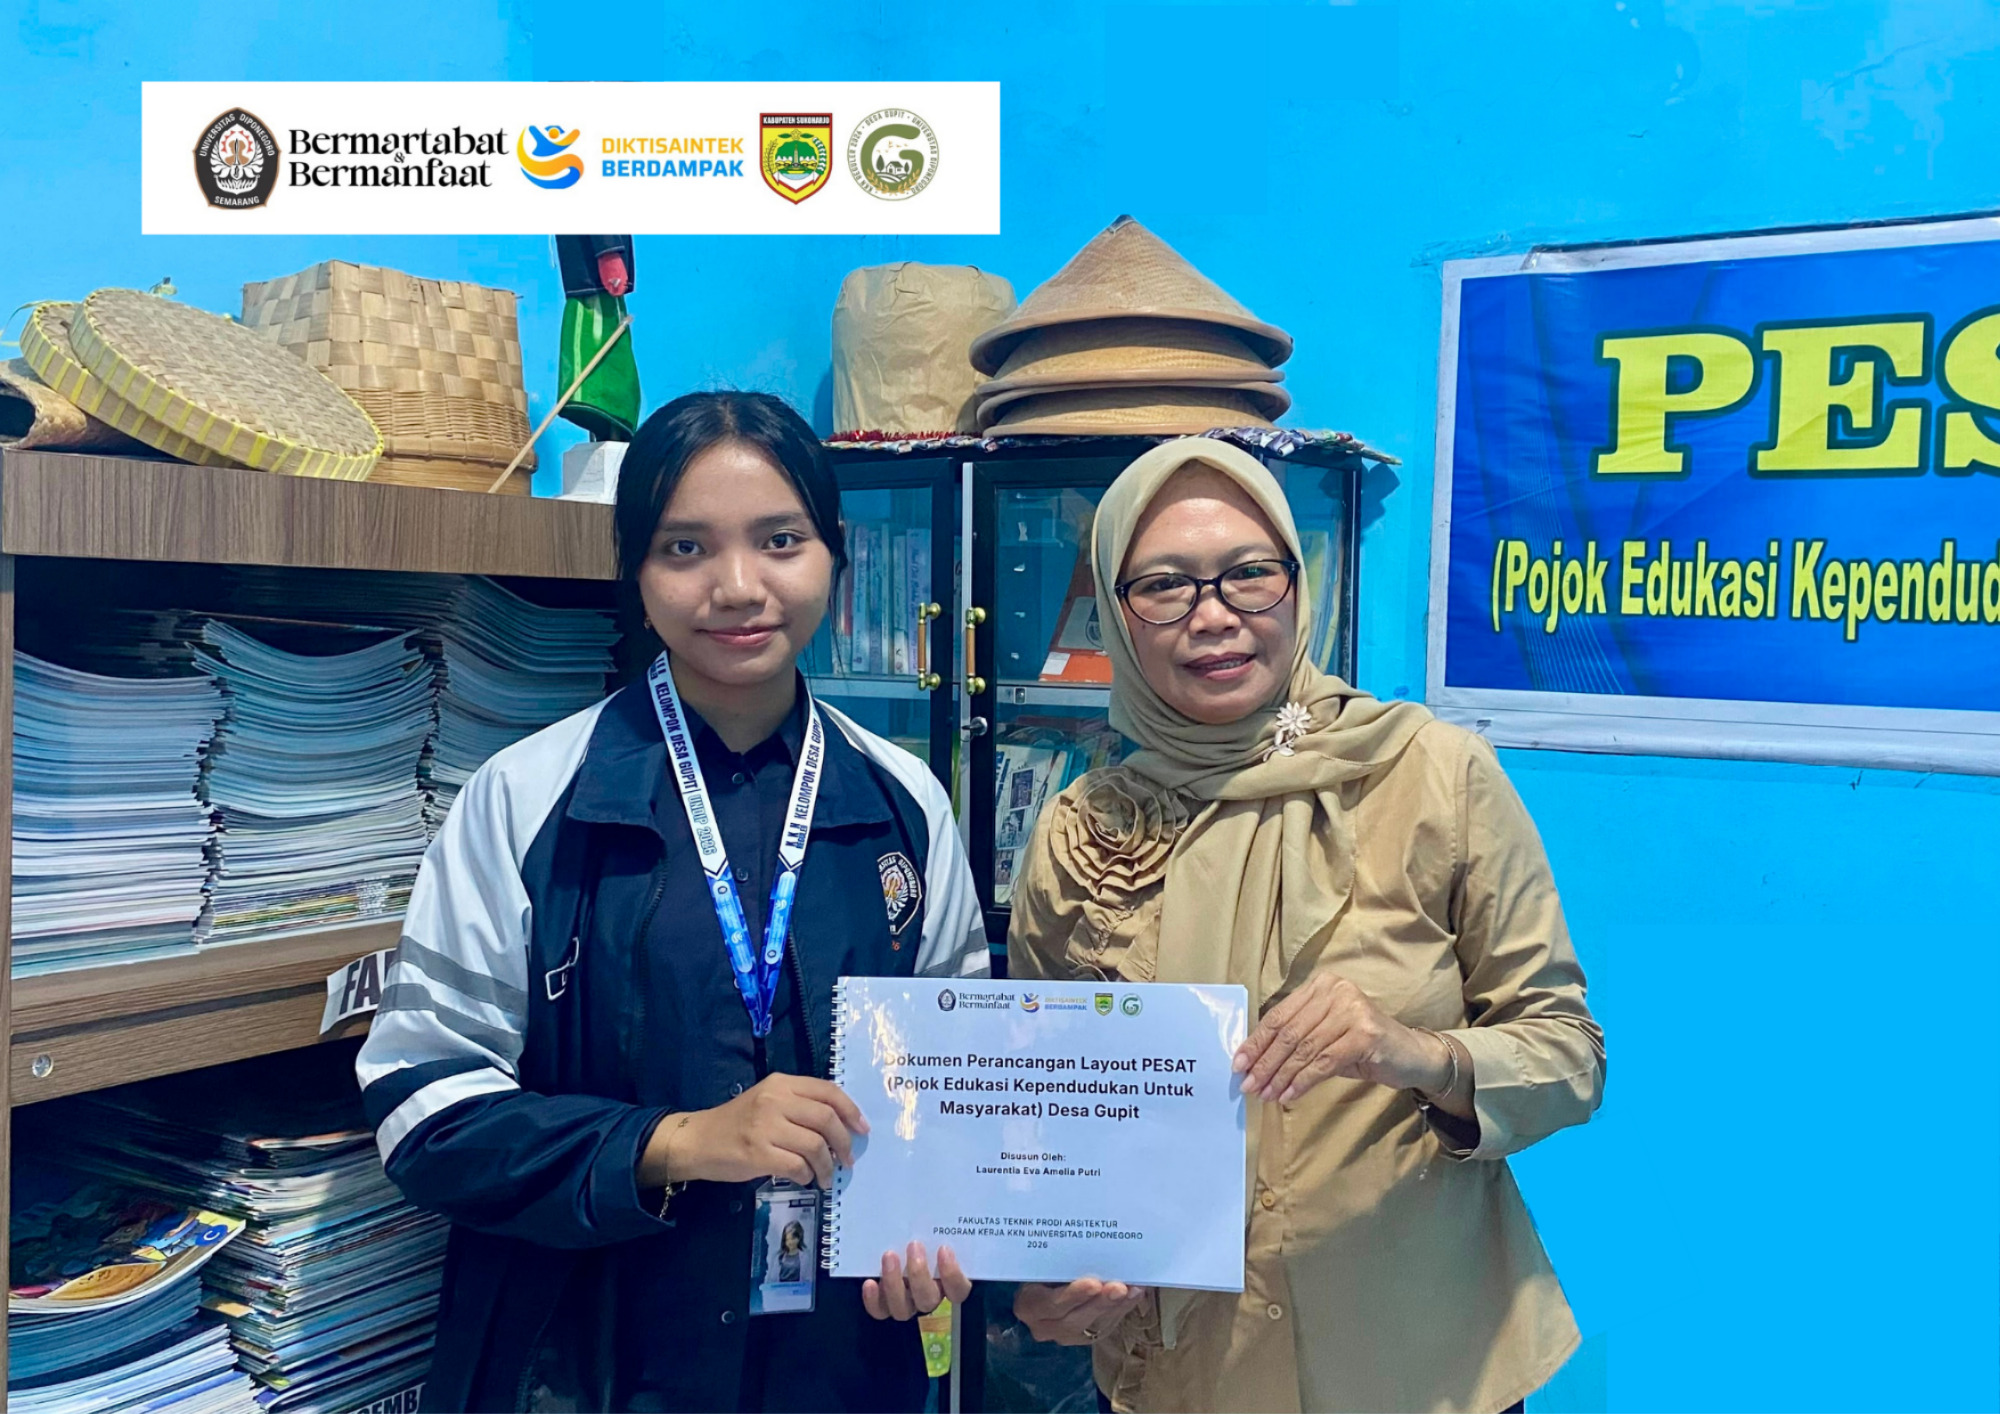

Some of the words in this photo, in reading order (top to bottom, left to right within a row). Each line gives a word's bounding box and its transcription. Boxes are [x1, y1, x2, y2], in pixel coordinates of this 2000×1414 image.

[1492, 539, 1609, 633] (Pojok
[1621, 541, 1778, 618] Edukasi
[654, 681, 682, 736] KELOMPOK
[670, 733, 688, 760] DESA
[678, 757, 699, 790] GUPIT
[793, 768, 816, 820] KELOMPOK
[807, 744, 820, 770] DESA
[967, 1054, 1076, 1073] Perancangan
[1081, 1056, 1138, 1074] Layout
[1142, 1058, 1197, 1074] PESAT
[887, 1076, 940, 1092] (Pojok
[944, 1077, 1009, 1092] Edukasi
[1013, 1078, 1139, 1096] Kependudukan
[1144, 1081, 1194, 1097] Untuk
[940, 1101, 1043, 1119] Masyarakat)
[1048, 1103, 1090, 1118] Desa
[1094, 1104, 1140, 1122] Gupit
[1000, 1152, 1039, 1161] Disusun
[1041, 1152, 1067, 1162] Oleh:
[976, 1165, 1021, 1175] Laurentia
[1023, 1166, 1040, 1175] Eva
[1042, 1167, 1075, 1176] Amelia
[1077, 1168, 1101, 1177] Putri
[958, 1216, 1001, 1225] FAKULTAS
[1003, 1217, 1034, 1226] TEKNIK
[1036, 1218, 1063, 1227] PRODI
[1064, 1219, 1118, 1228] ARSITEKTUR
[933, 1226, 976, 1236] PROGRAM
[978, 1227, 1005, 1237] KERJA
[1007, 1229, 1026, 1237] KKN
[1028, 1229, 1084, 1239] UNIVERSITAS
[1085, 1231, 1144, 1240] DIPONEGORO
[1026, 1240, 1049, 1249] 2026
